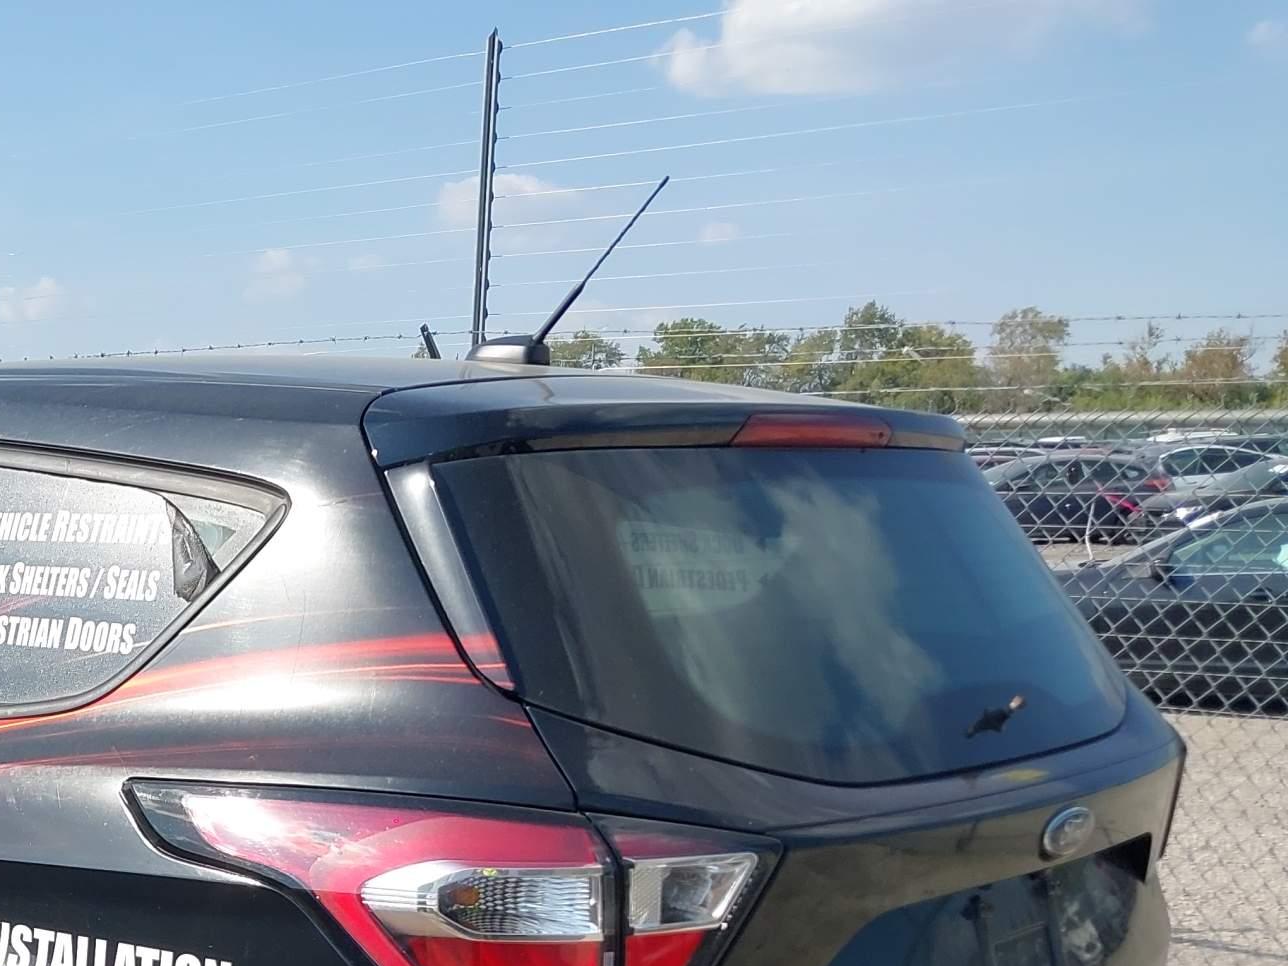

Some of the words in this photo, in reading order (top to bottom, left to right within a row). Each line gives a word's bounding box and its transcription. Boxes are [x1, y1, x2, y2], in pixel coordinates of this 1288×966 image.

[10, 561, 90, 598] SHELTERS
[90, 566, 102, 598] /
[103, 565, 161, 602] SEALS
[64, 616, 137, 656] DOORS
